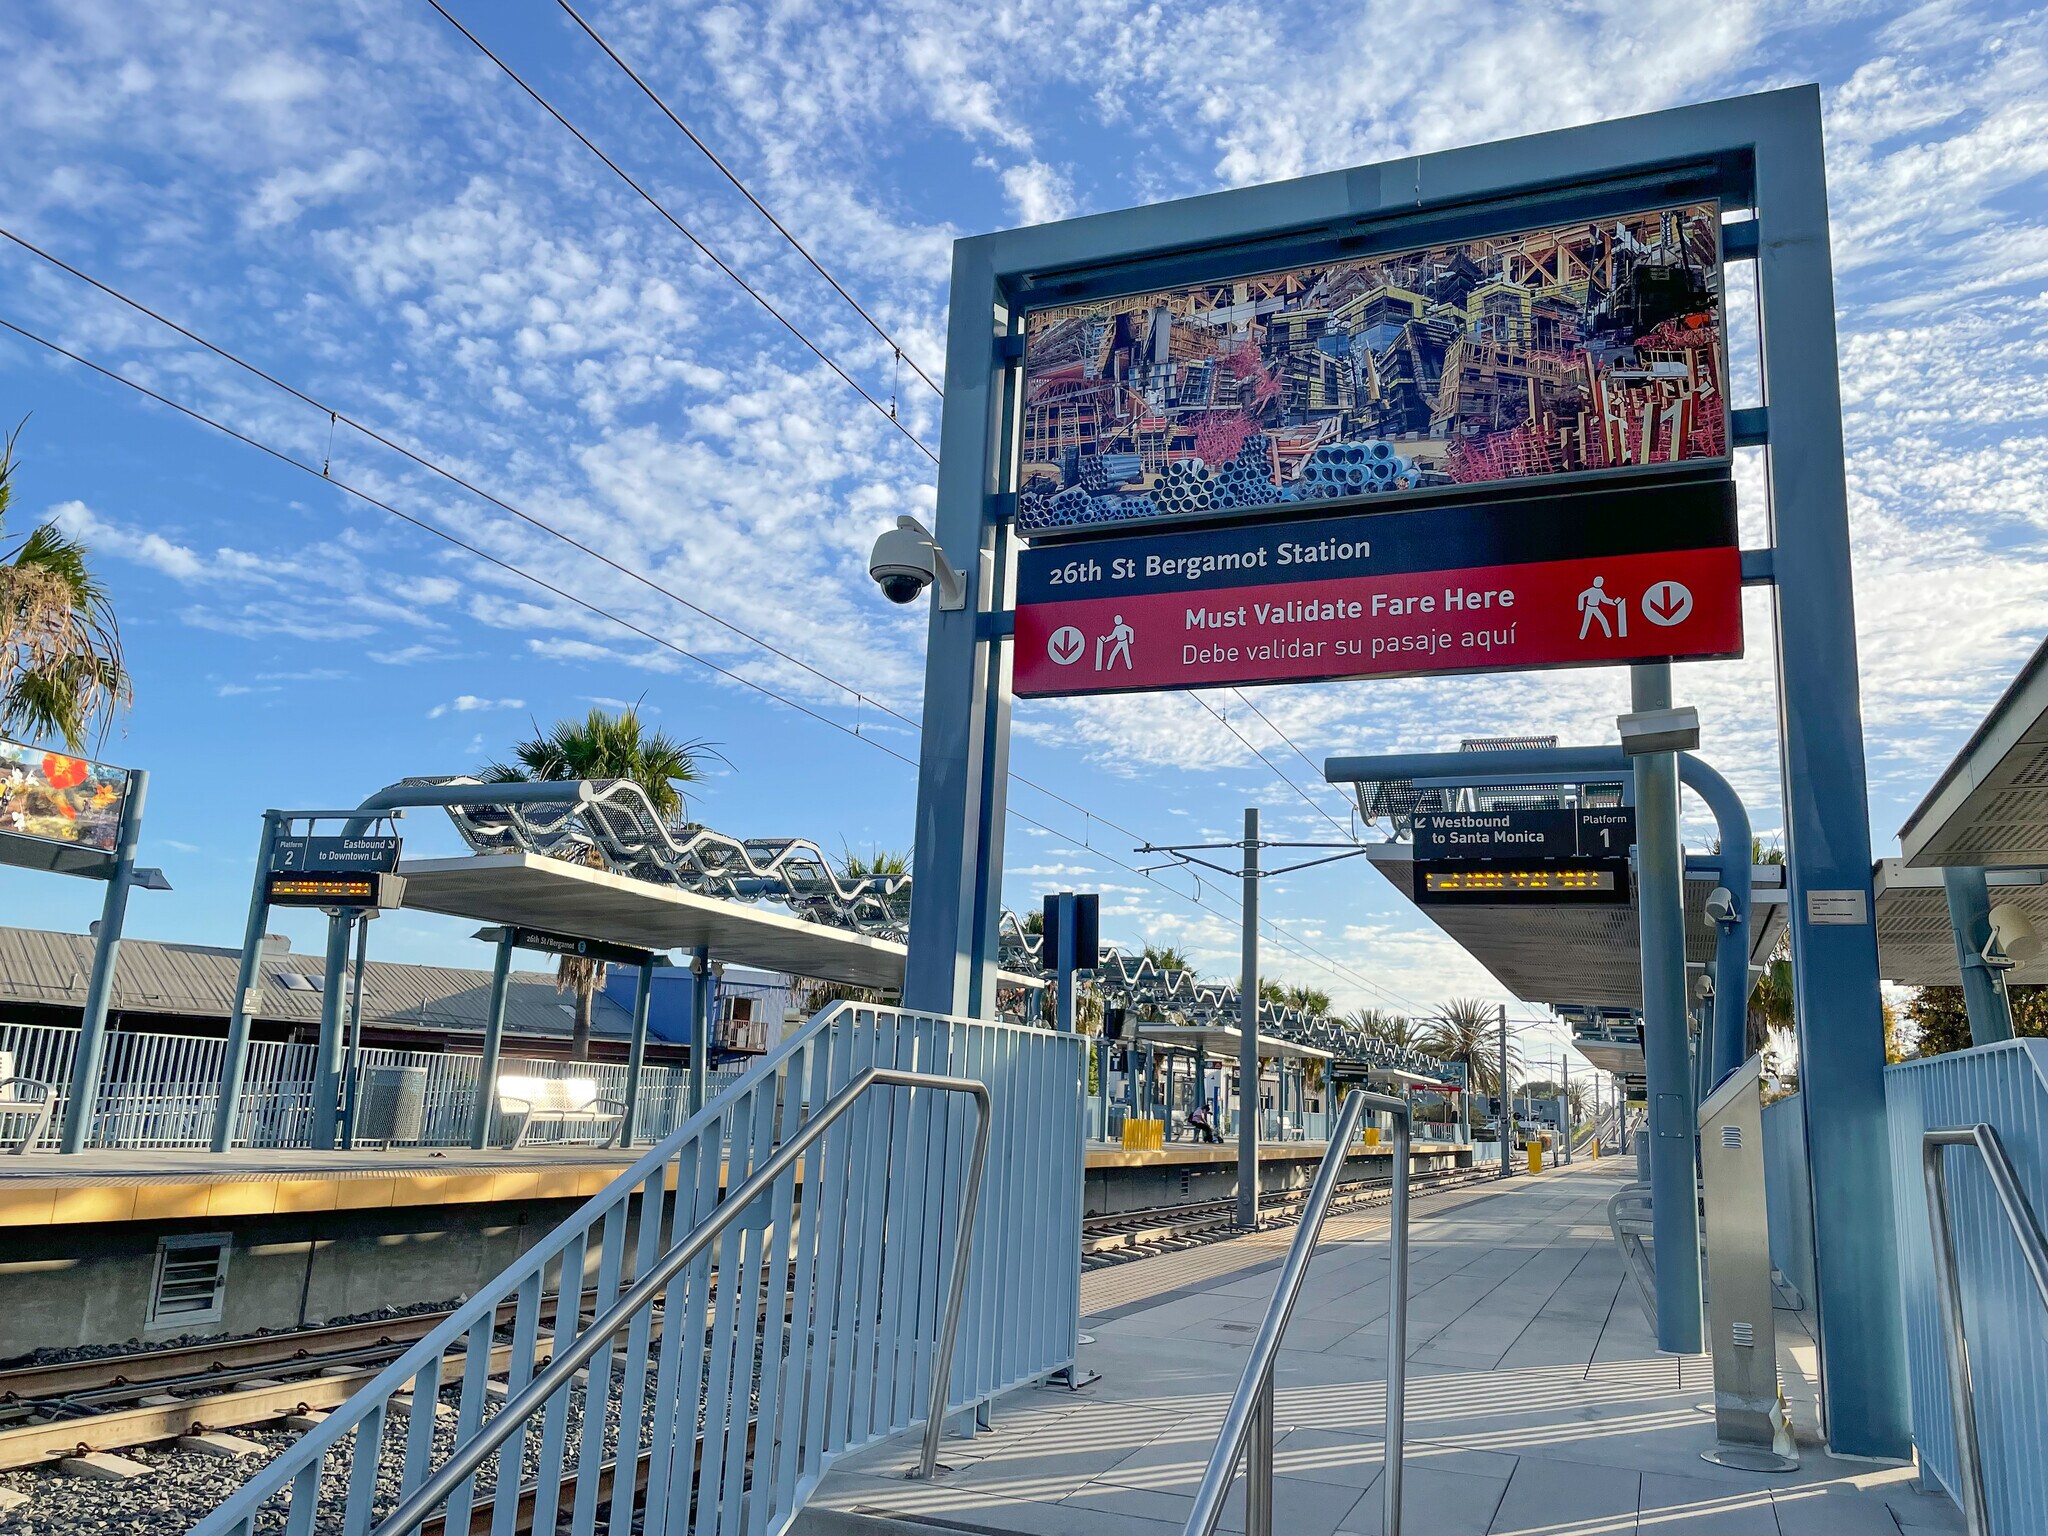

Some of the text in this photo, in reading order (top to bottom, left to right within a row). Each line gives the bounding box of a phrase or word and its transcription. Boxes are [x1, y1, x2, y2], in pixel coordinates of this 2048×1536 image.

[1049, 537, 1371, 585] 26th St Bergamot Station
[1185, 587, 1516, 630] Must Validate Fare Here
[1182, 621, 1518, 666] Debe validar su pasaje aquí
[1431, 814, 1511, 829] Westbound
[1582, 814, 1628, 825] Platform
[279, 840, 304, 849] Platform
[343, 839, 386, 849] Eastbound
[1431, 829, 1546, 845] to Santa Monica
[1599, 827, 1610, 848] 1
[284, 850, 294, 865] 2
[319, 850, 383, 861] to Downtown LA
[526, 934, 540, 944] 26th
